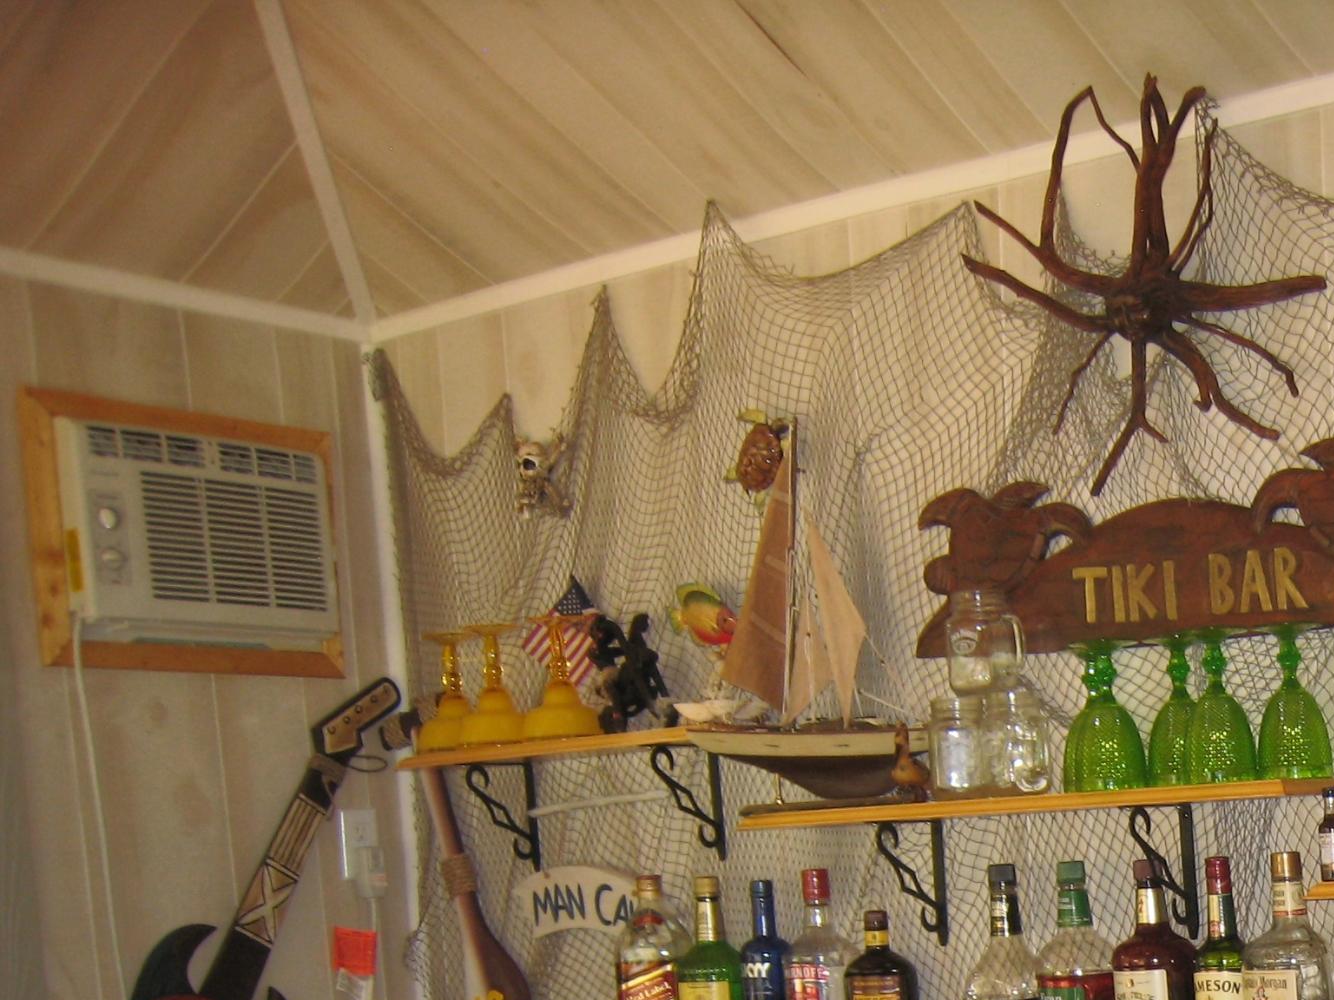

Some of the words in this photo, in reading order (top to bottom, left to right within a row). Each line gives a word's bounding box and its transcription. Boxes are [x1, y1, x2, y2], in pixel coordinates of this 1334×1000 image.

[1072, 560, 1178, 624] TIKI
[1208, 546, 1309, 616] BAR
[532, 882, 586, 927] MAN
